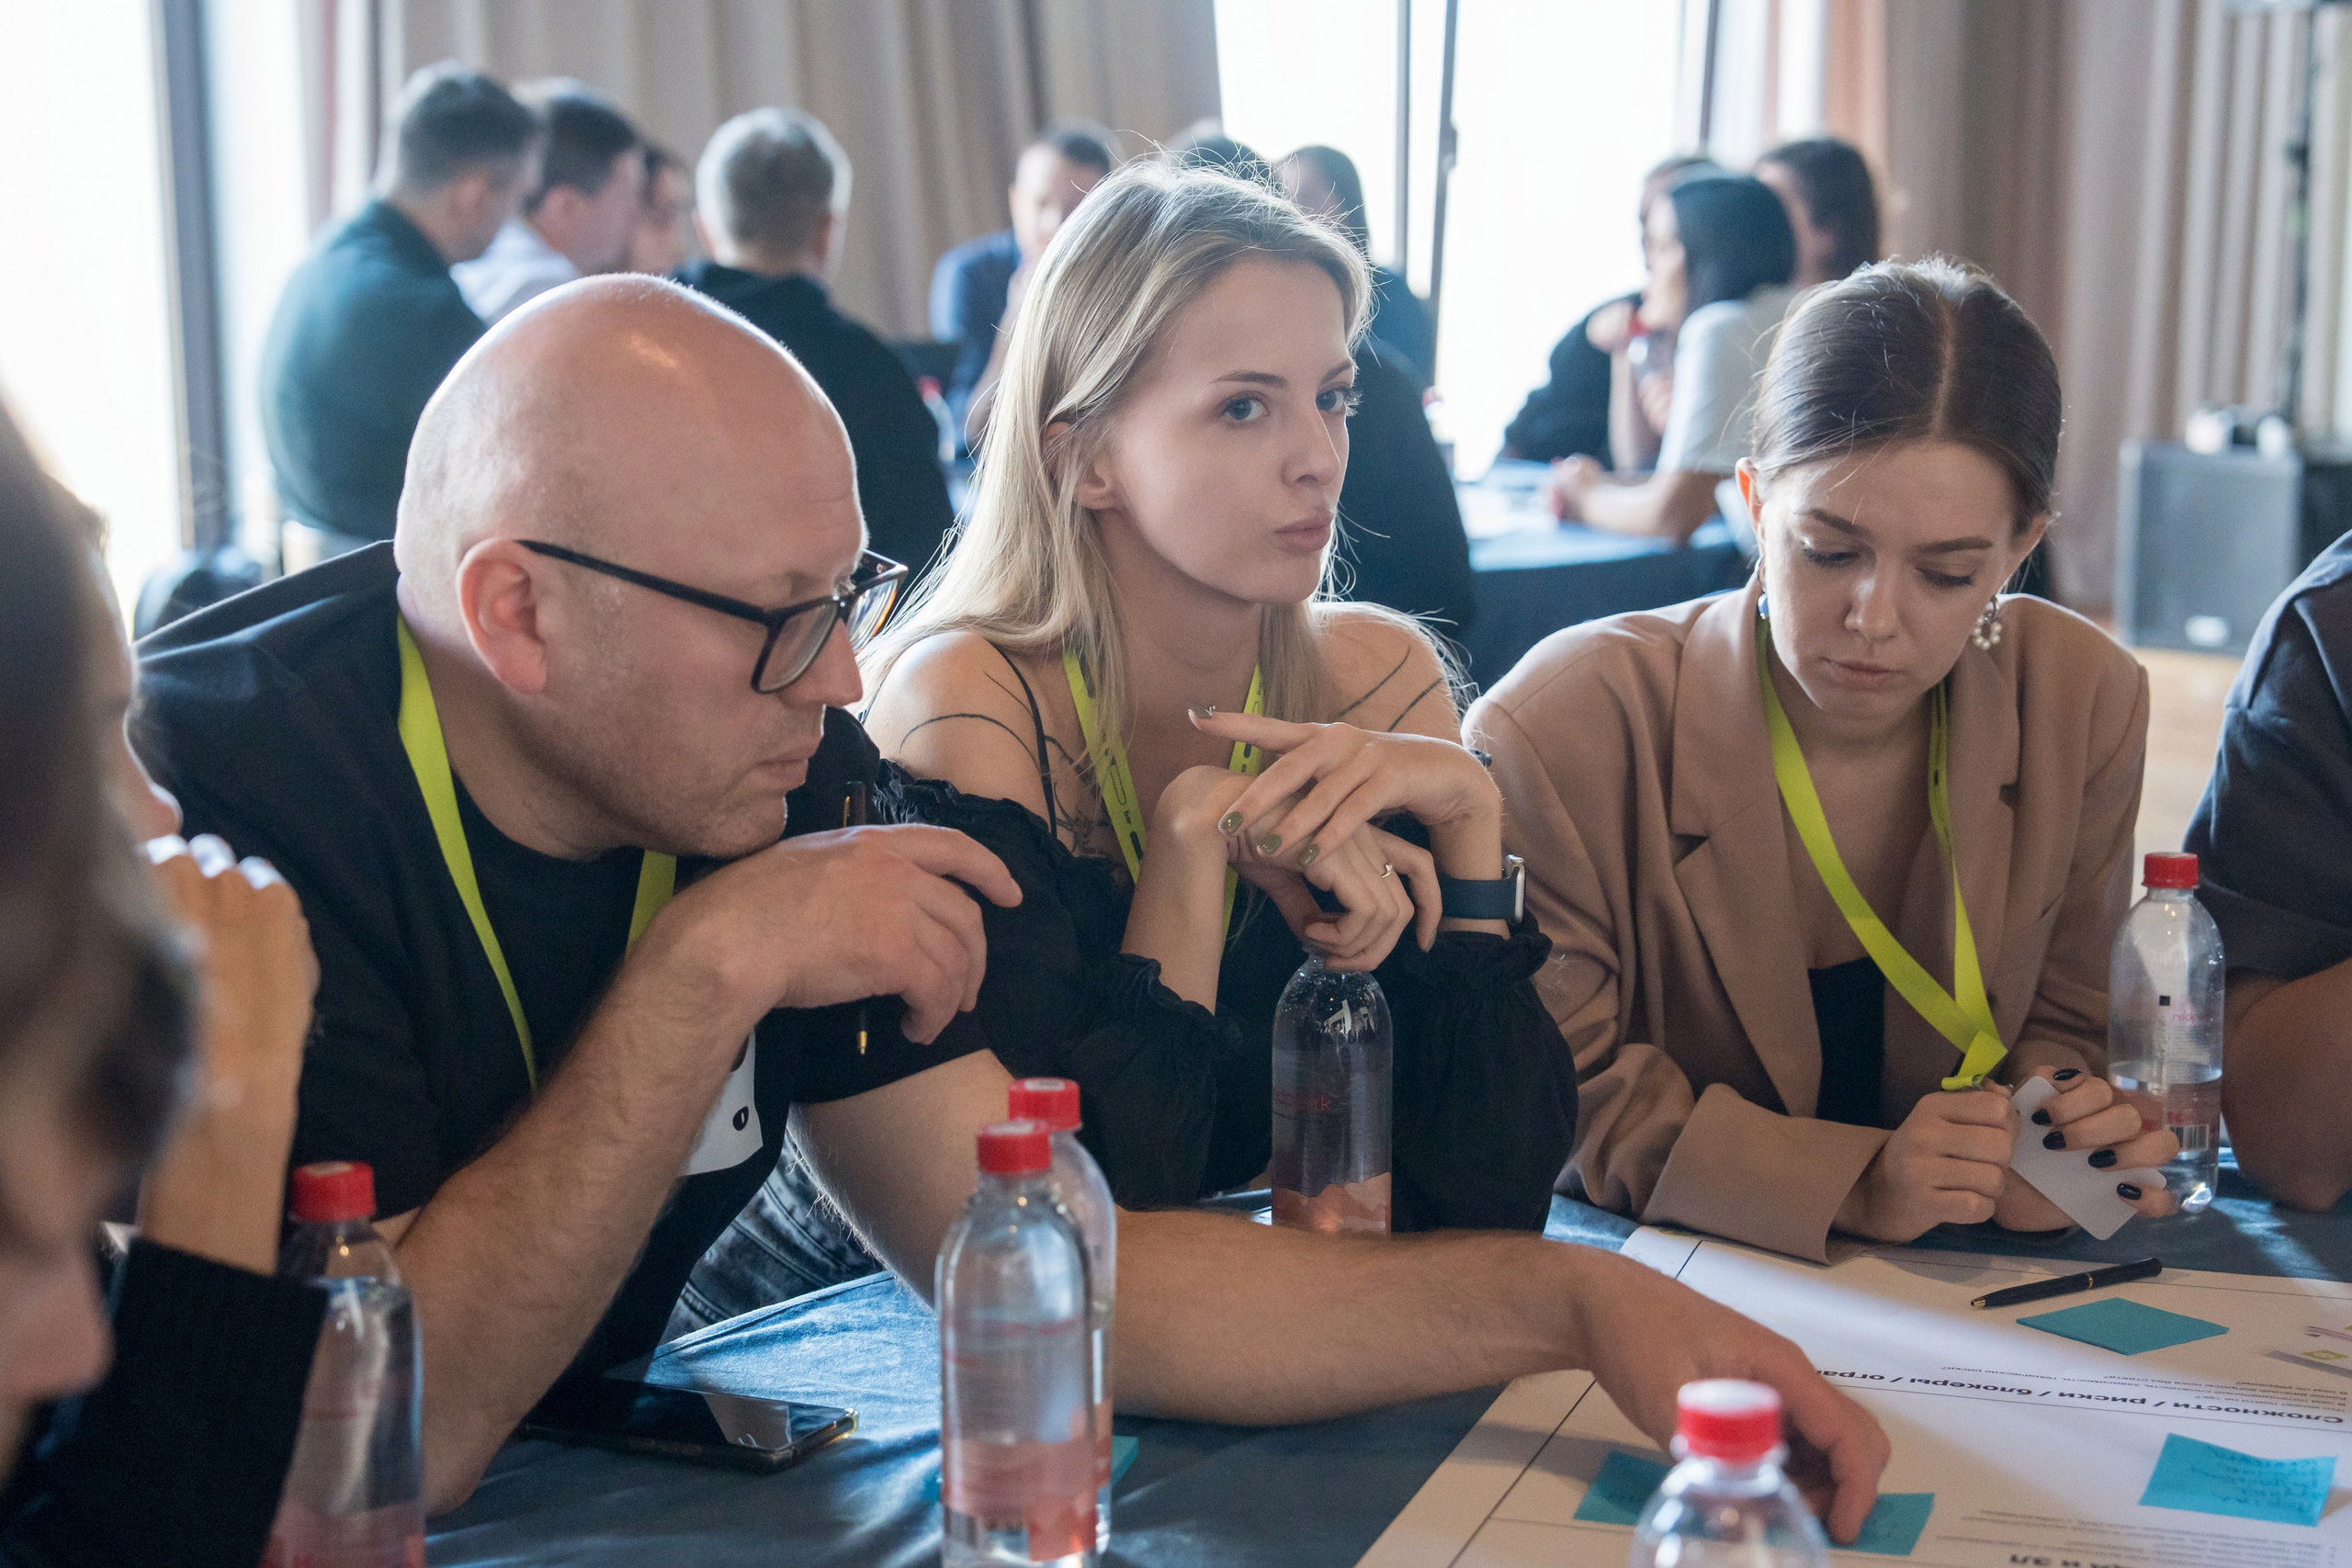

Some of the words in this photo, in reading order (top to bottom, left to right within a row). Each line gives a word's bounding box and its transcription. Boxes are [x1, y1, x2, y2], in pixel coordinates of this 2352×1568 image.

[1984, 1370, 2057, 1381] технические
[1910, 1378, 2032, 1395] блокеры
[2058, 1392, 2146, 1405] риски
[2173, 1402, 2344, 1424] Сложности
